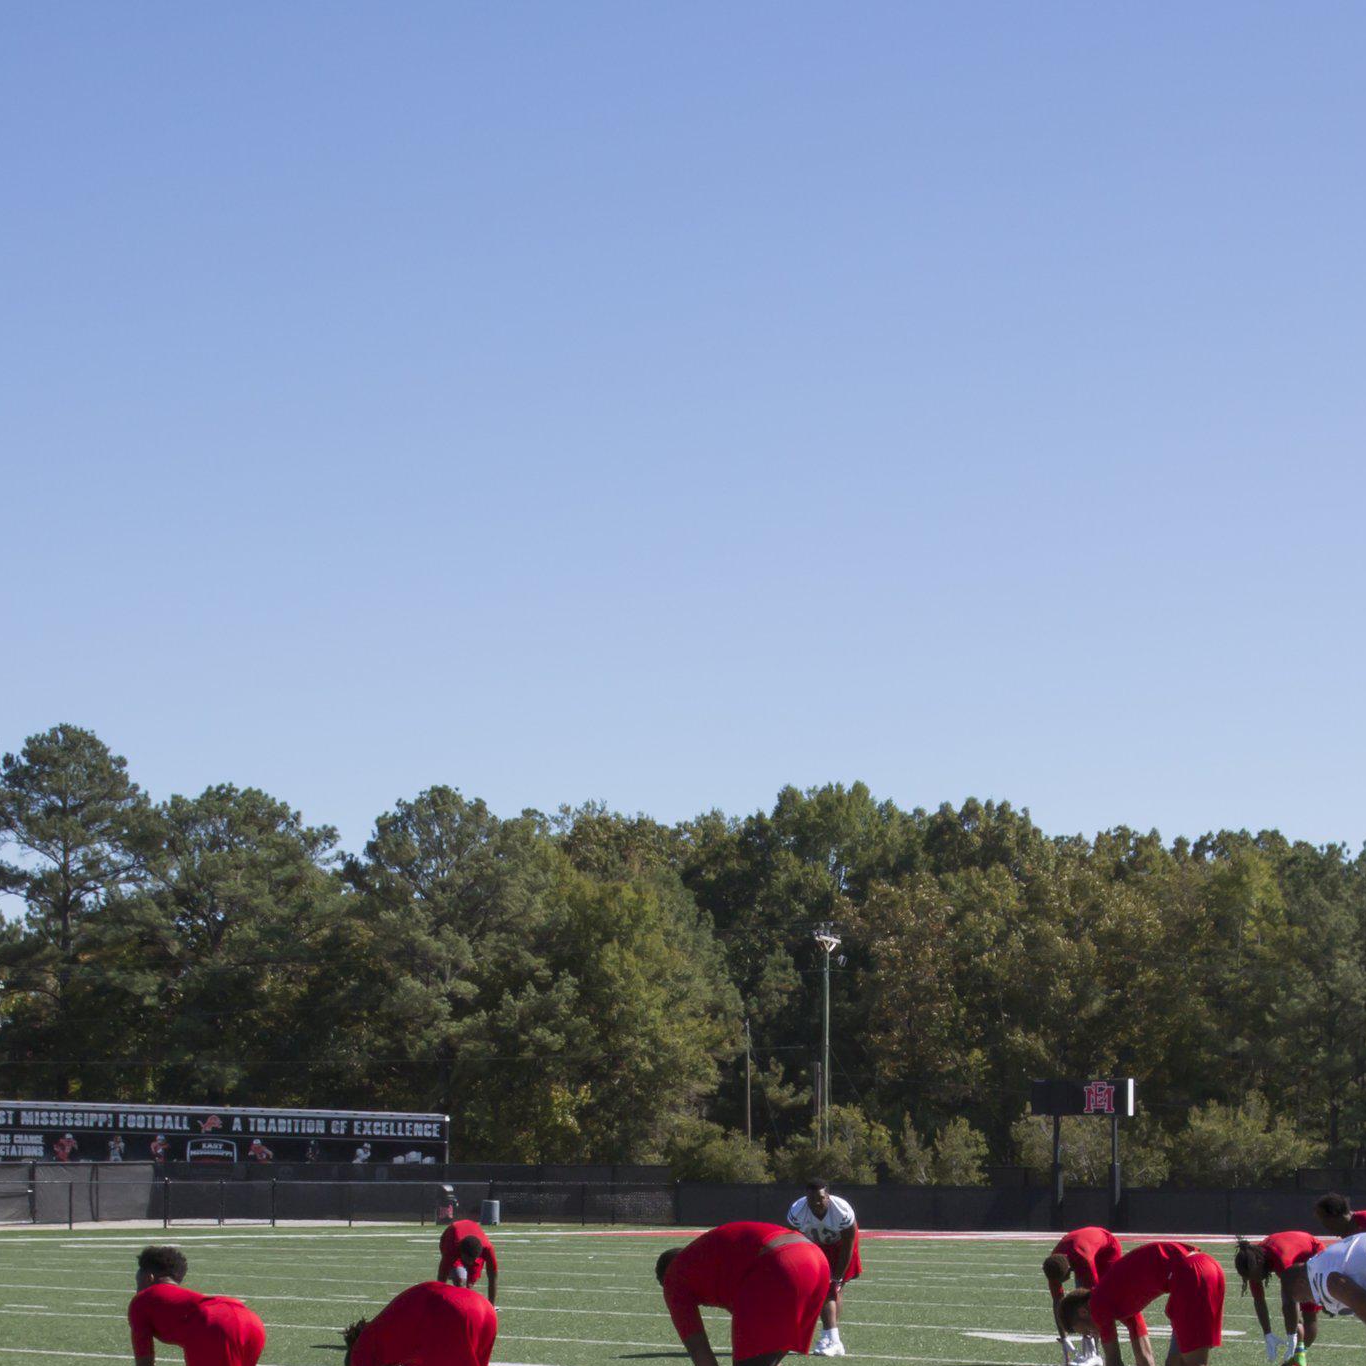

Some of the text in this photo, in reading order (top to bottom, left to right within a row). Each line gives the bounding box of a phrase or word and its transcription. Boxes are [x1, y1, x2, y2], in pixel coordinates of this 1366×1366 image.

[20, 1110, 113, 1128] MISSISSIPPI
[118, 1114, 190, 1131] FOOTBALL
[232, 1116, 440, 1138] A TRADITION OF EXCELLENCE
[201, 1142, 224, 1150] EAST
